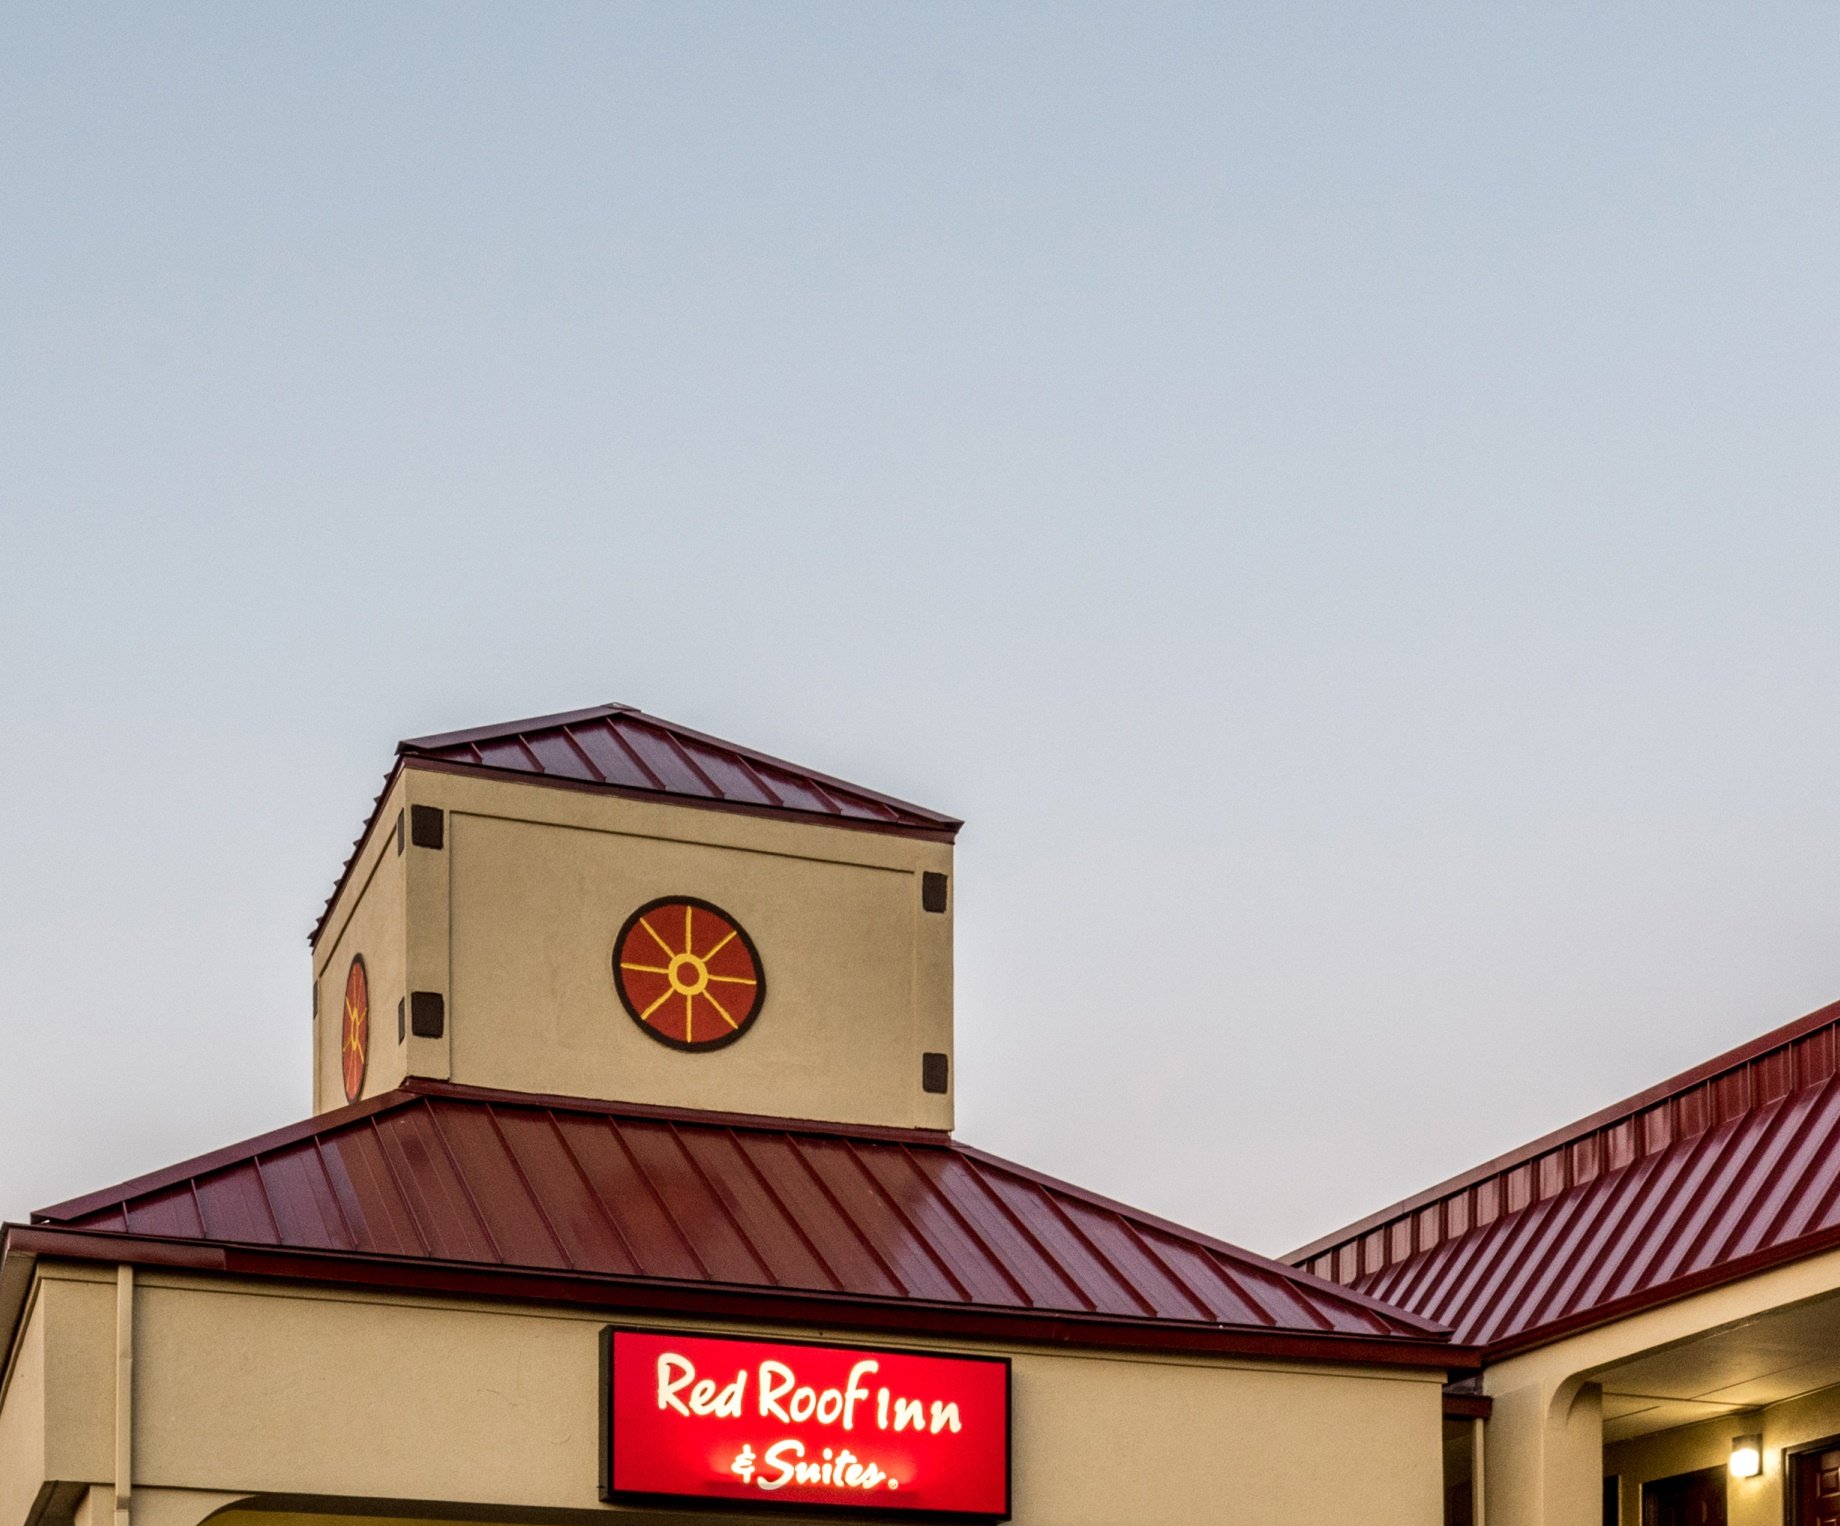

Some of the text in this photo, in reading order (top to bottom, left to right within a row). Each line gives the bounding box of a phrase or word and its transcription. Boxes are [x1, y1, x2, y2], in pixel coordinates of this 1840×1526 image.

[657, 1352, 963, 1435] Red Roof Inn
[730, 1438, 888, 1491] & Suites
